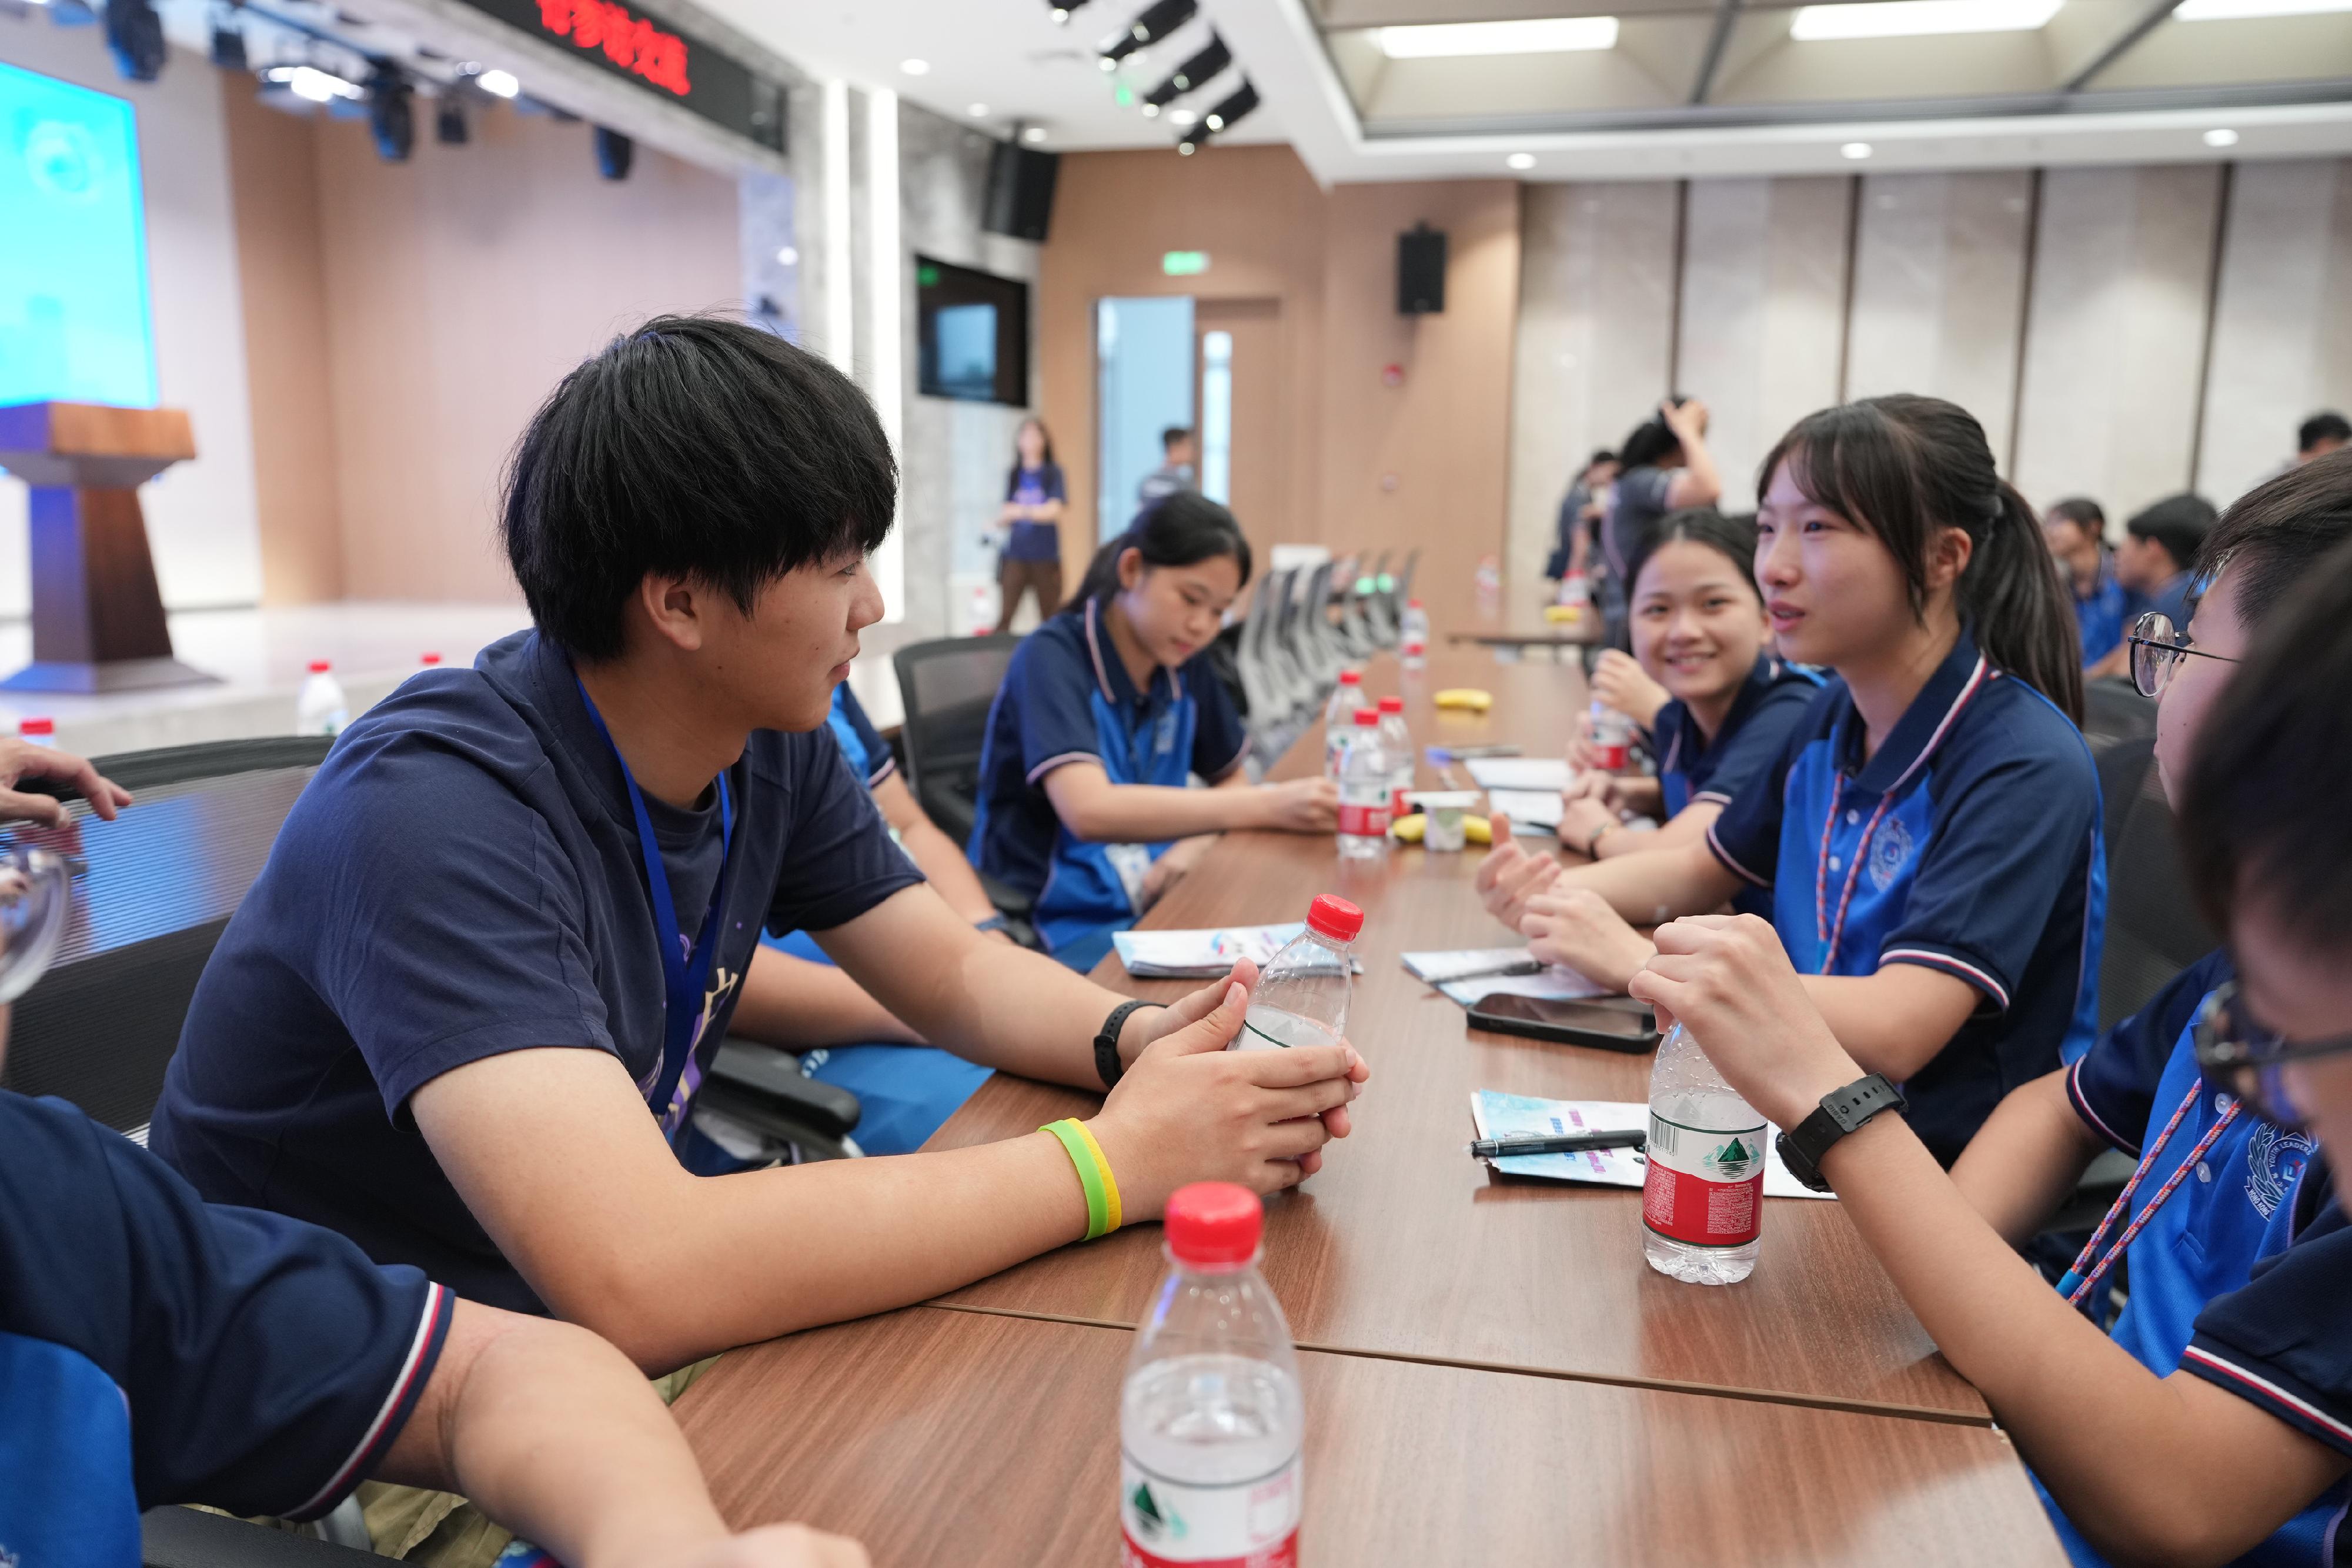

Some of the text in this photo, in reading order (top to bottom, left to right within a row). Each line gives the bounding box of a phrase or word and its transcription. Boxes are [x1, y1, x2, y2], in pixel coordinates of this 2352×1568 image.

[2269, 1142, 2311, 1168] YOUTH LEADERS
[2249, 1188, 2270, 1216] HONG KONG
